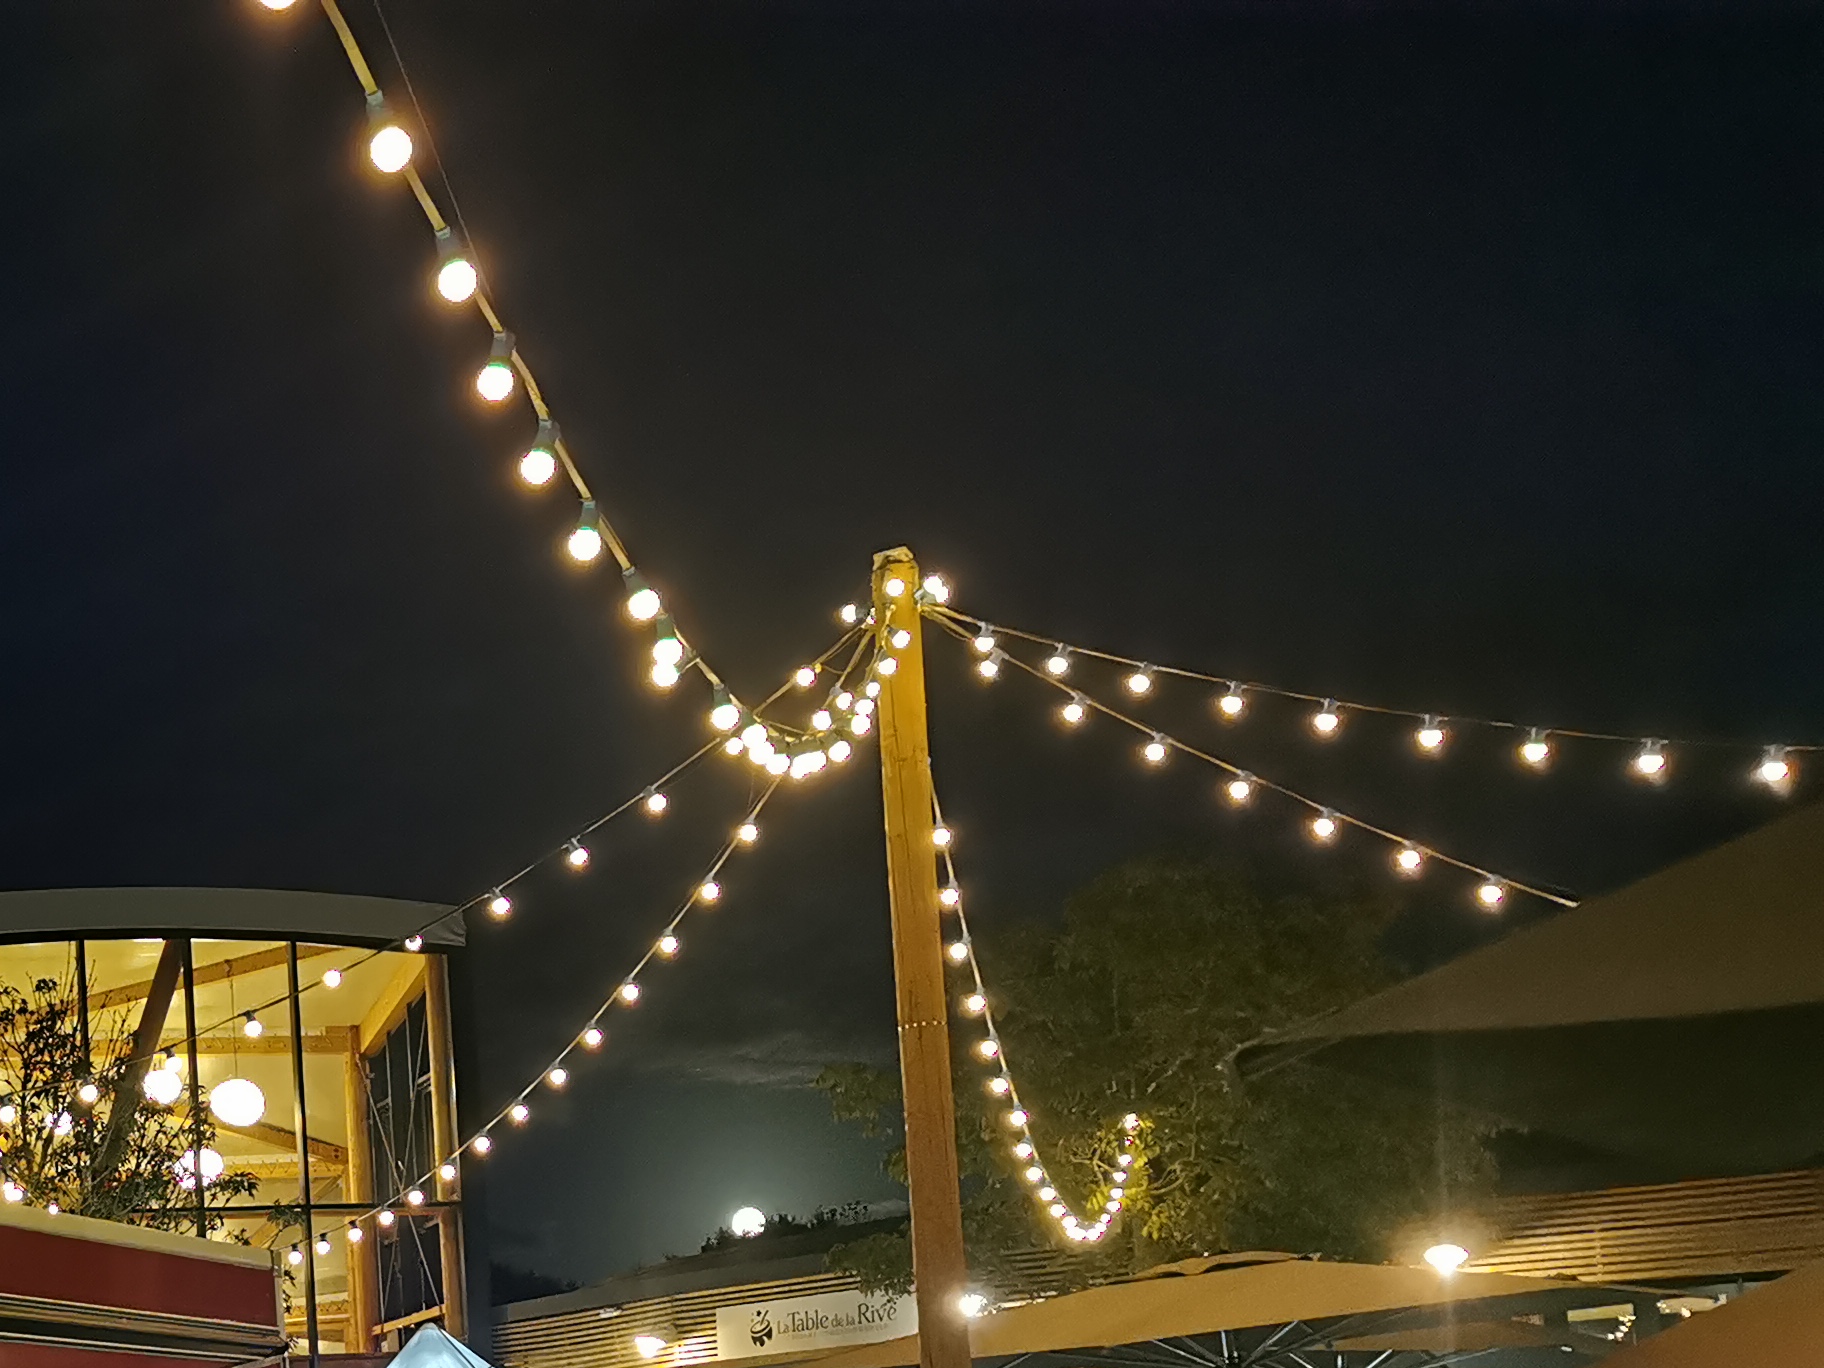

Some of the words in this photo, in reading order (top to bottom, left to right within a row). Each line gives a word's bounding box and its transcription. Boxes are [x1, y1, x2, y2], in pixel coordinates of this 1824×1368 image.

[777, 1320, 790, 1334] La
[787, 1309, 829, 1332] Table
[831, 1313, 844, 1328] de
[845, 1312, 855, 1326] la
[857, 1303, 897, 1325] Rive
